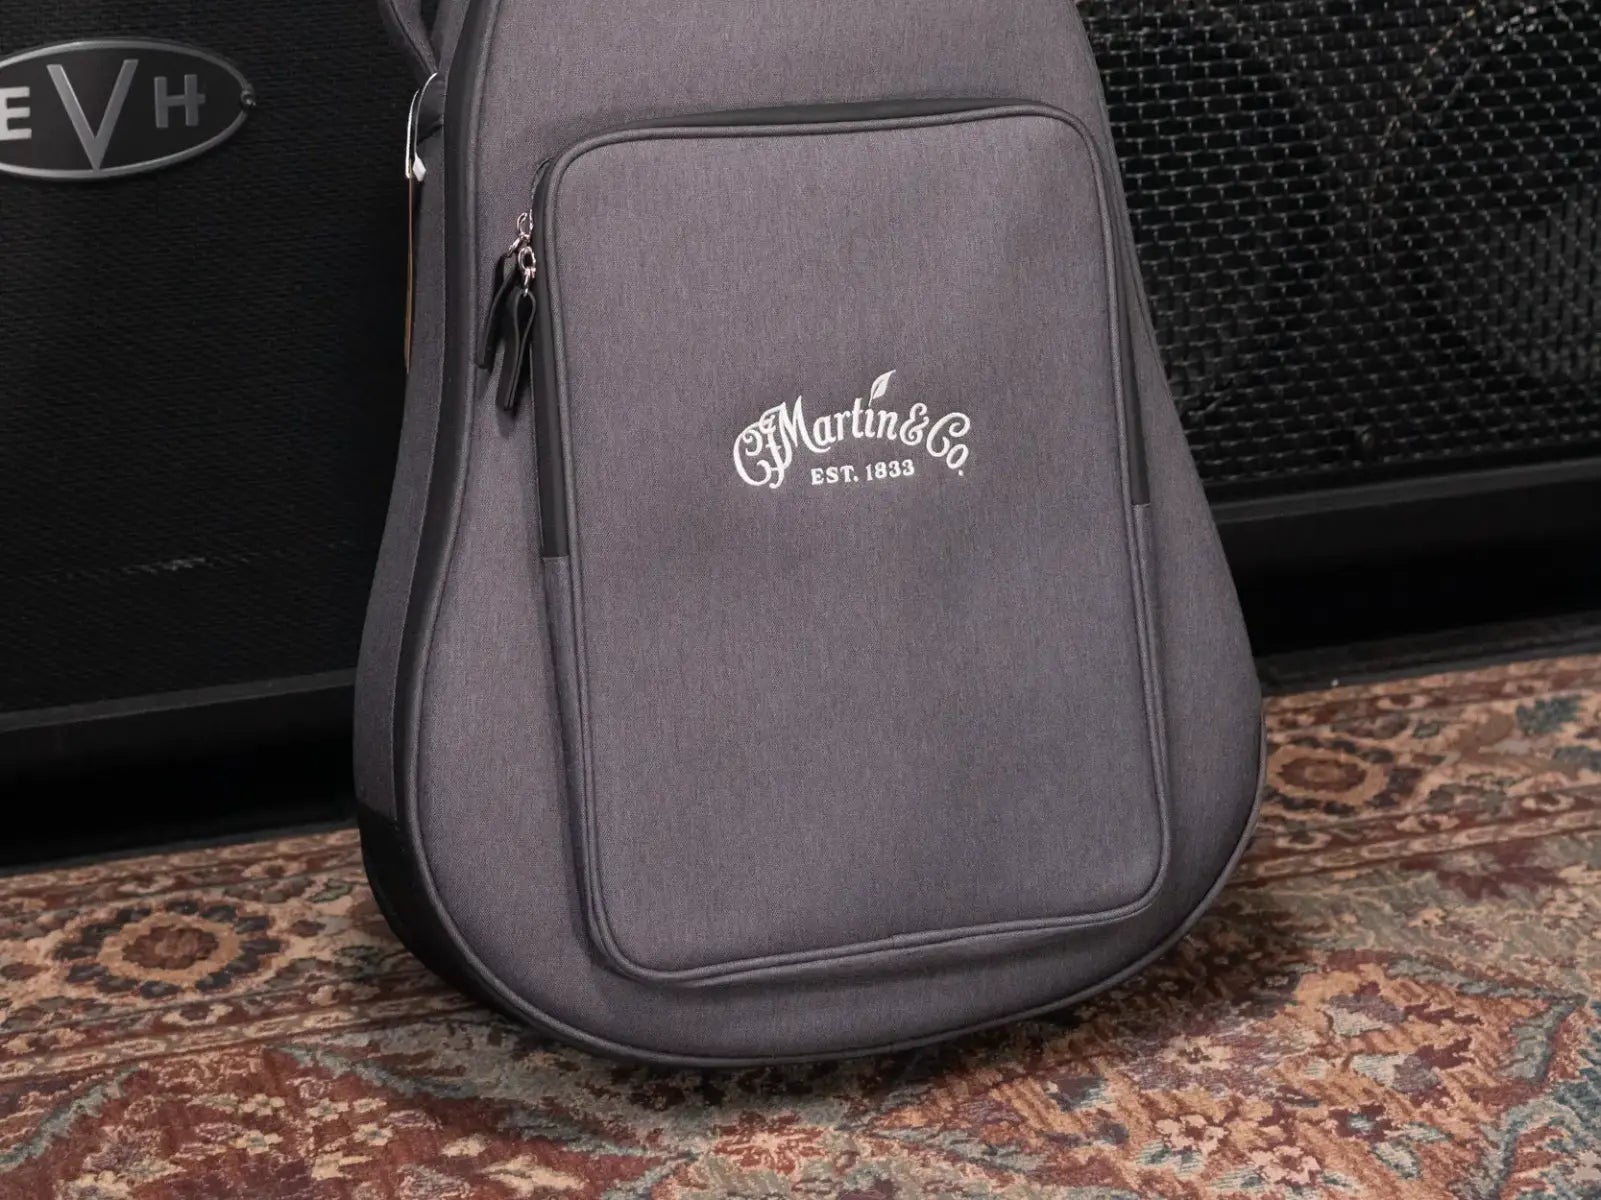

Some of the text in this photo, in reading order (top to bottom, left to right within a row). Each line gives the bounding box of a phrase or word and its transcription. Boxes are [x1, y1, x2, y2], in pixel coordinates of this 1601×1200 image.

[0, 58, 206, 172] EVH
[810, 458, 916, 486] EST. 1833
